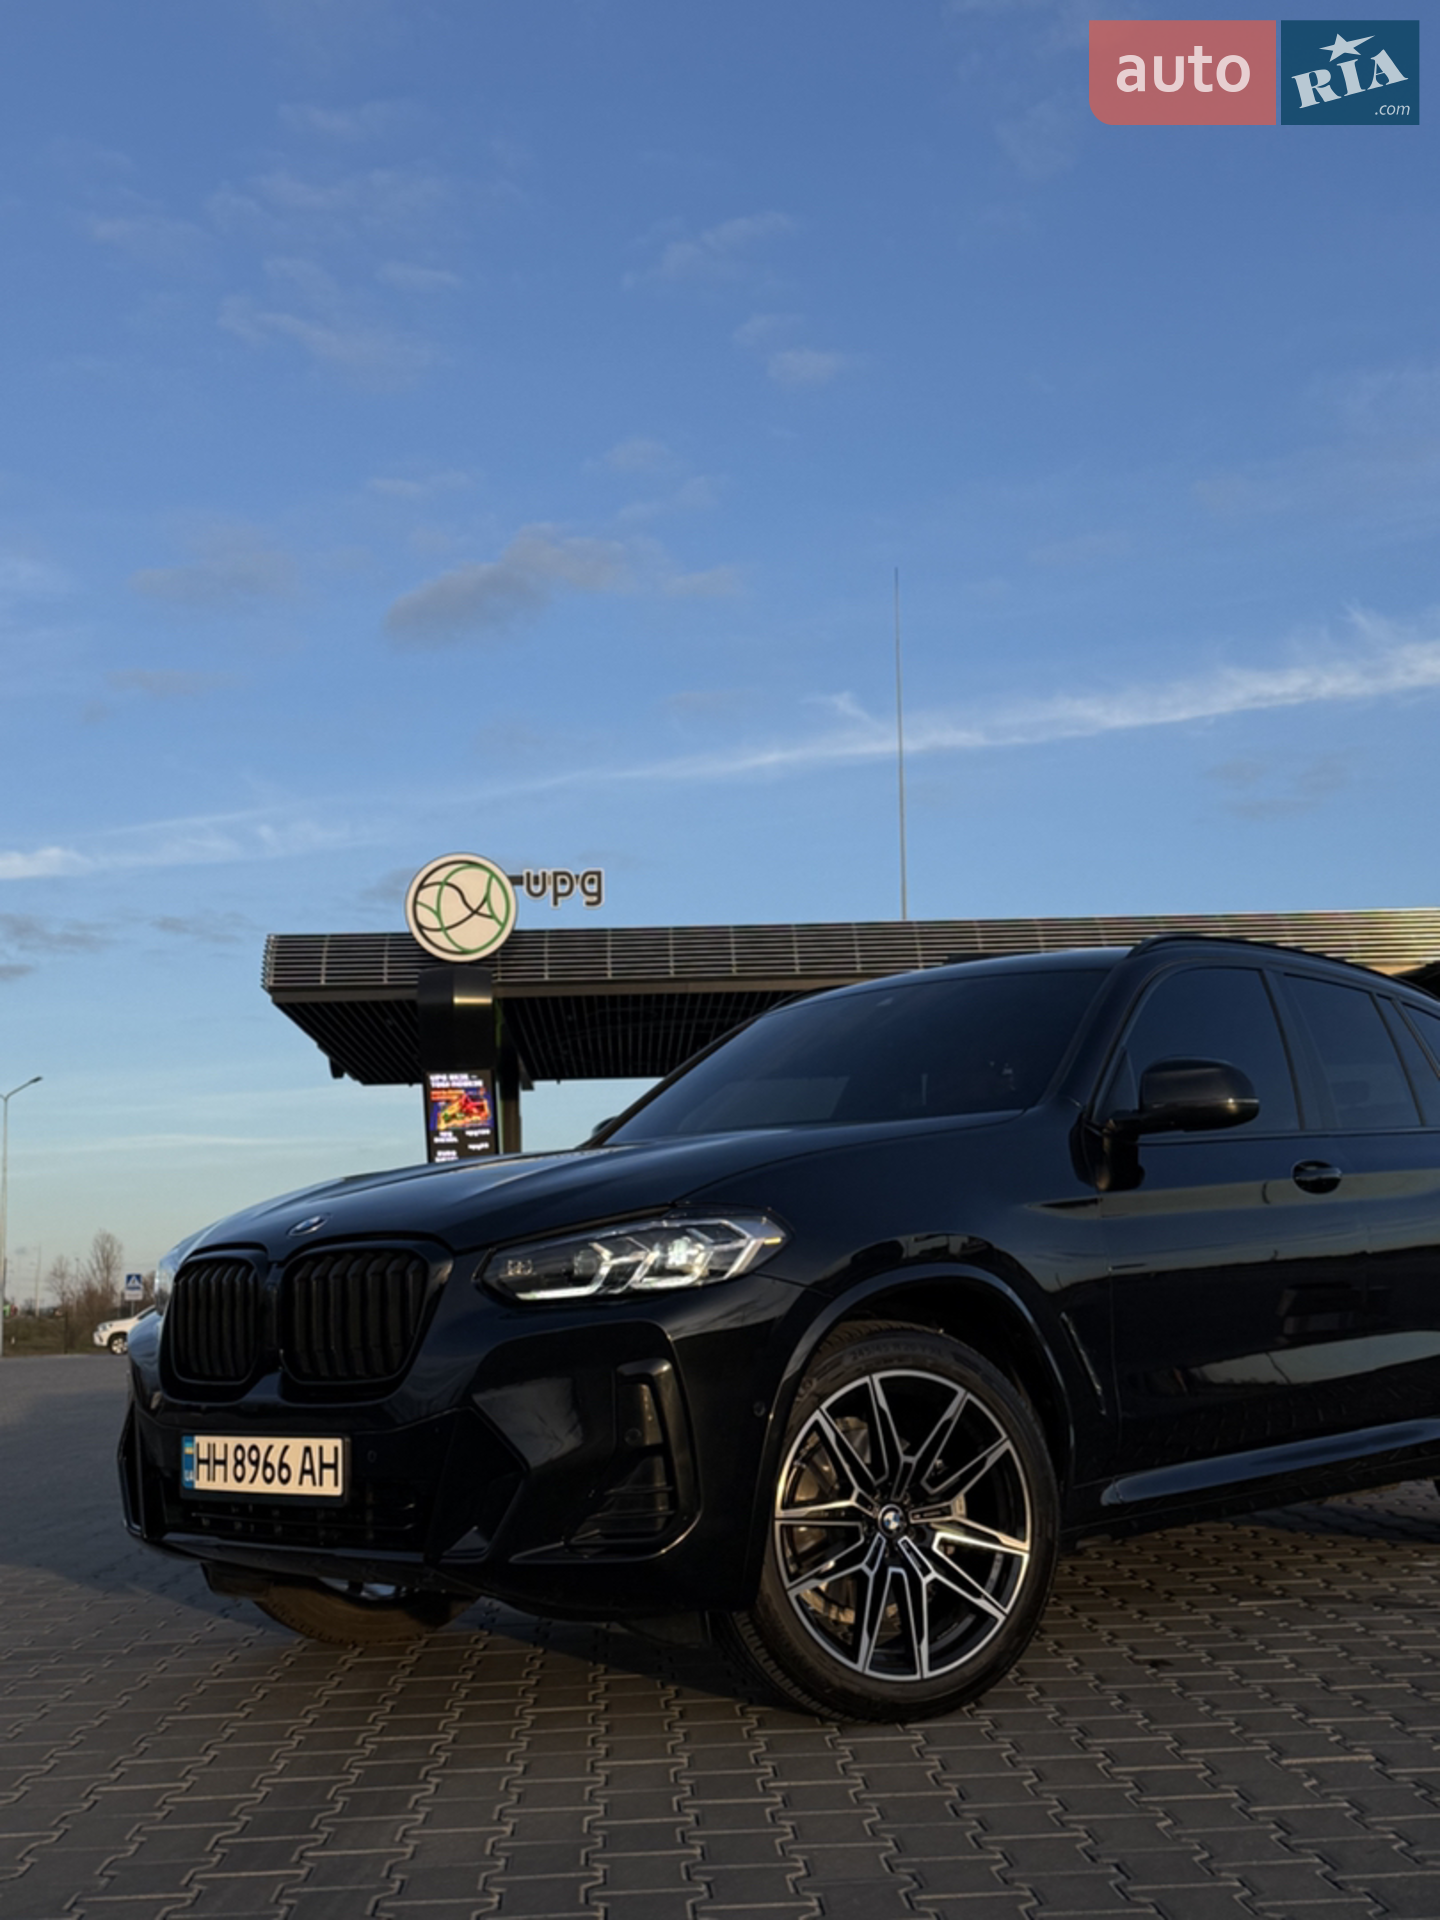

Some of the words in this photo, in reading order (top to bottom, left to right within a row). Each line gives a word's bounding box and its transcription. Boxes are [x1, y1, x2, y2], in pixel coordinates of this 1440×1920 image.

[524, 868, 604, 907] upg
[233, 1443, 292, 1485] 8966
[298, 1445, 339, 1487] AH
